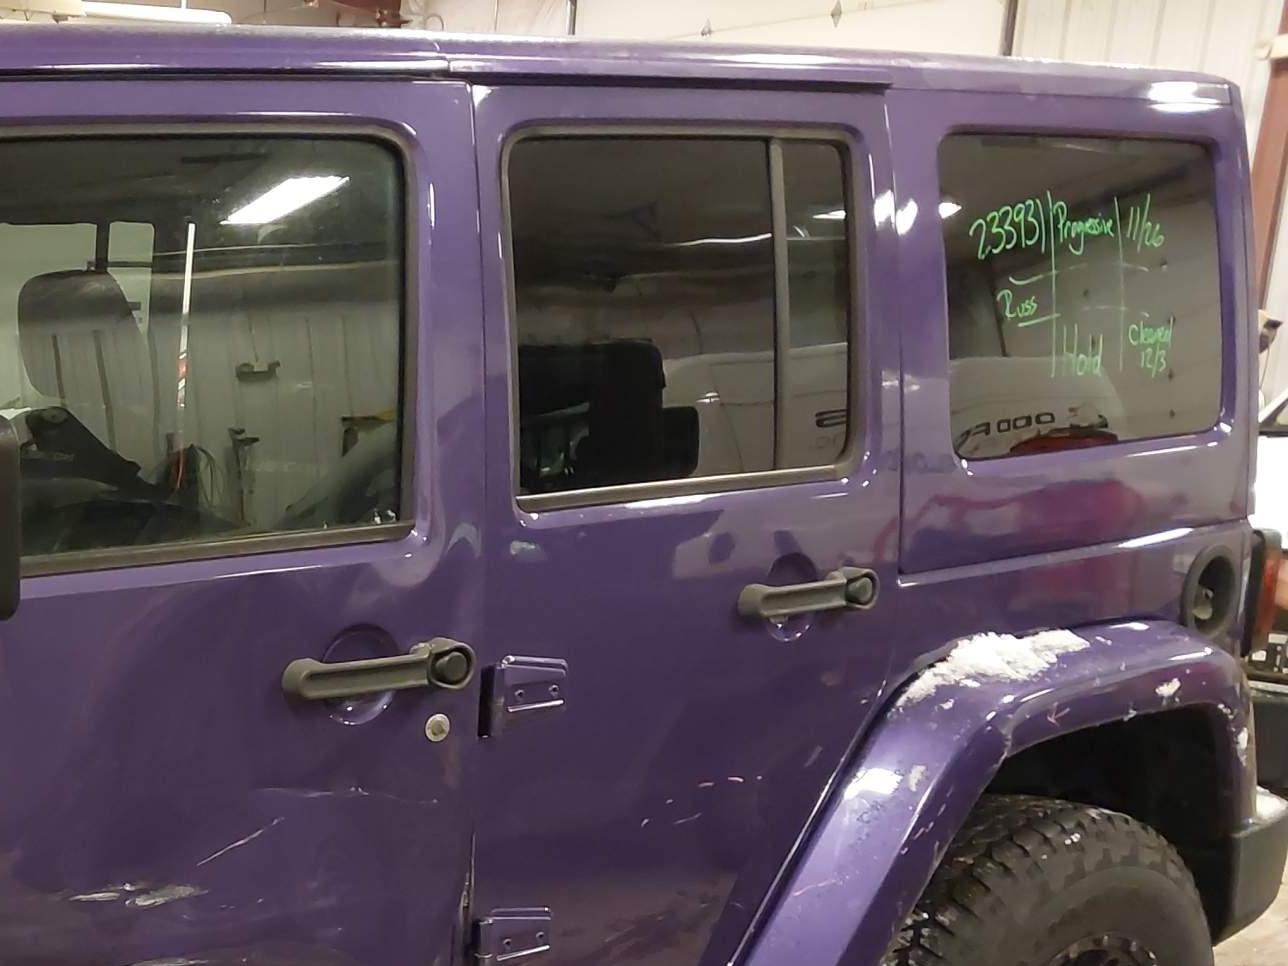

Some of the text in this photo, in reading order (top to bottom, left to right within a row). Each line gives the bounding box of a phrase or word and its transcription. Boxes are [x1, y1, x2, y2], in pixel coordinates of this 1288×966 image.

[1126, 193, 1165, 253] 11/26
[997, 289, 1039, 320] Russ
[1062, 323, 1104, 377] Hold
